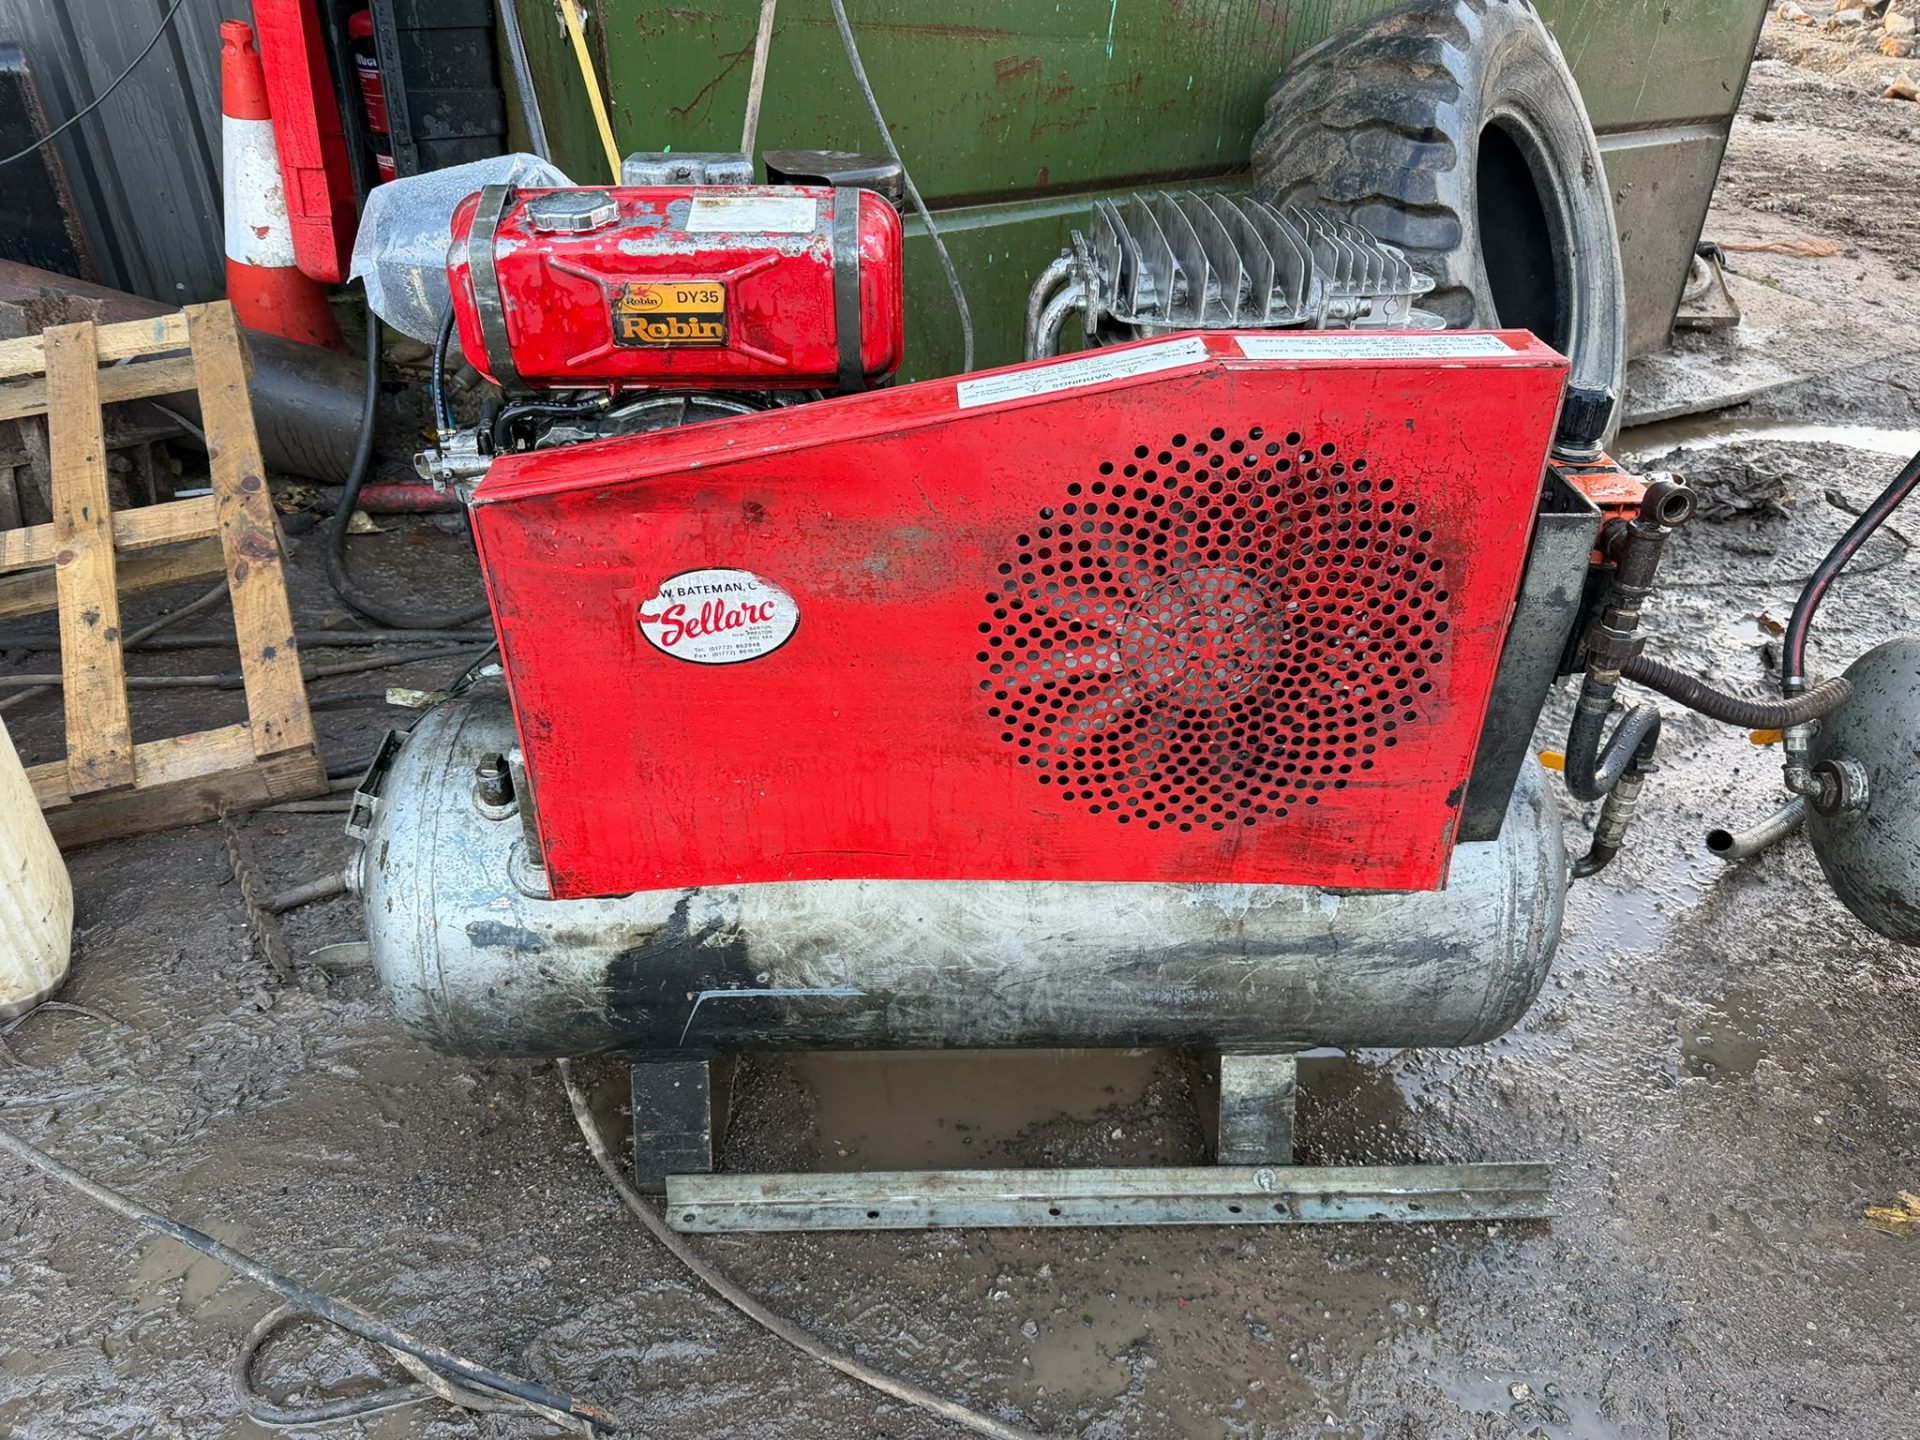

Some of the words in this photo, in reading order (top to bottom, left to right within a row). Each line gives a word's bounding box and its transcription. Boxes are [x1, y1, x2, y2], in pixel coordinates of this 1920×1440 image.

[625, 297, 658, 306] Robin
[676, 290, 719, 304] DY35
[623, 316, 723, 342] Robin
[1051, 372, 1113, 389] WARNINGS
[677, 582, 746, 597] BATEMAN,
[660, 597, 775, 647] Sellarc
